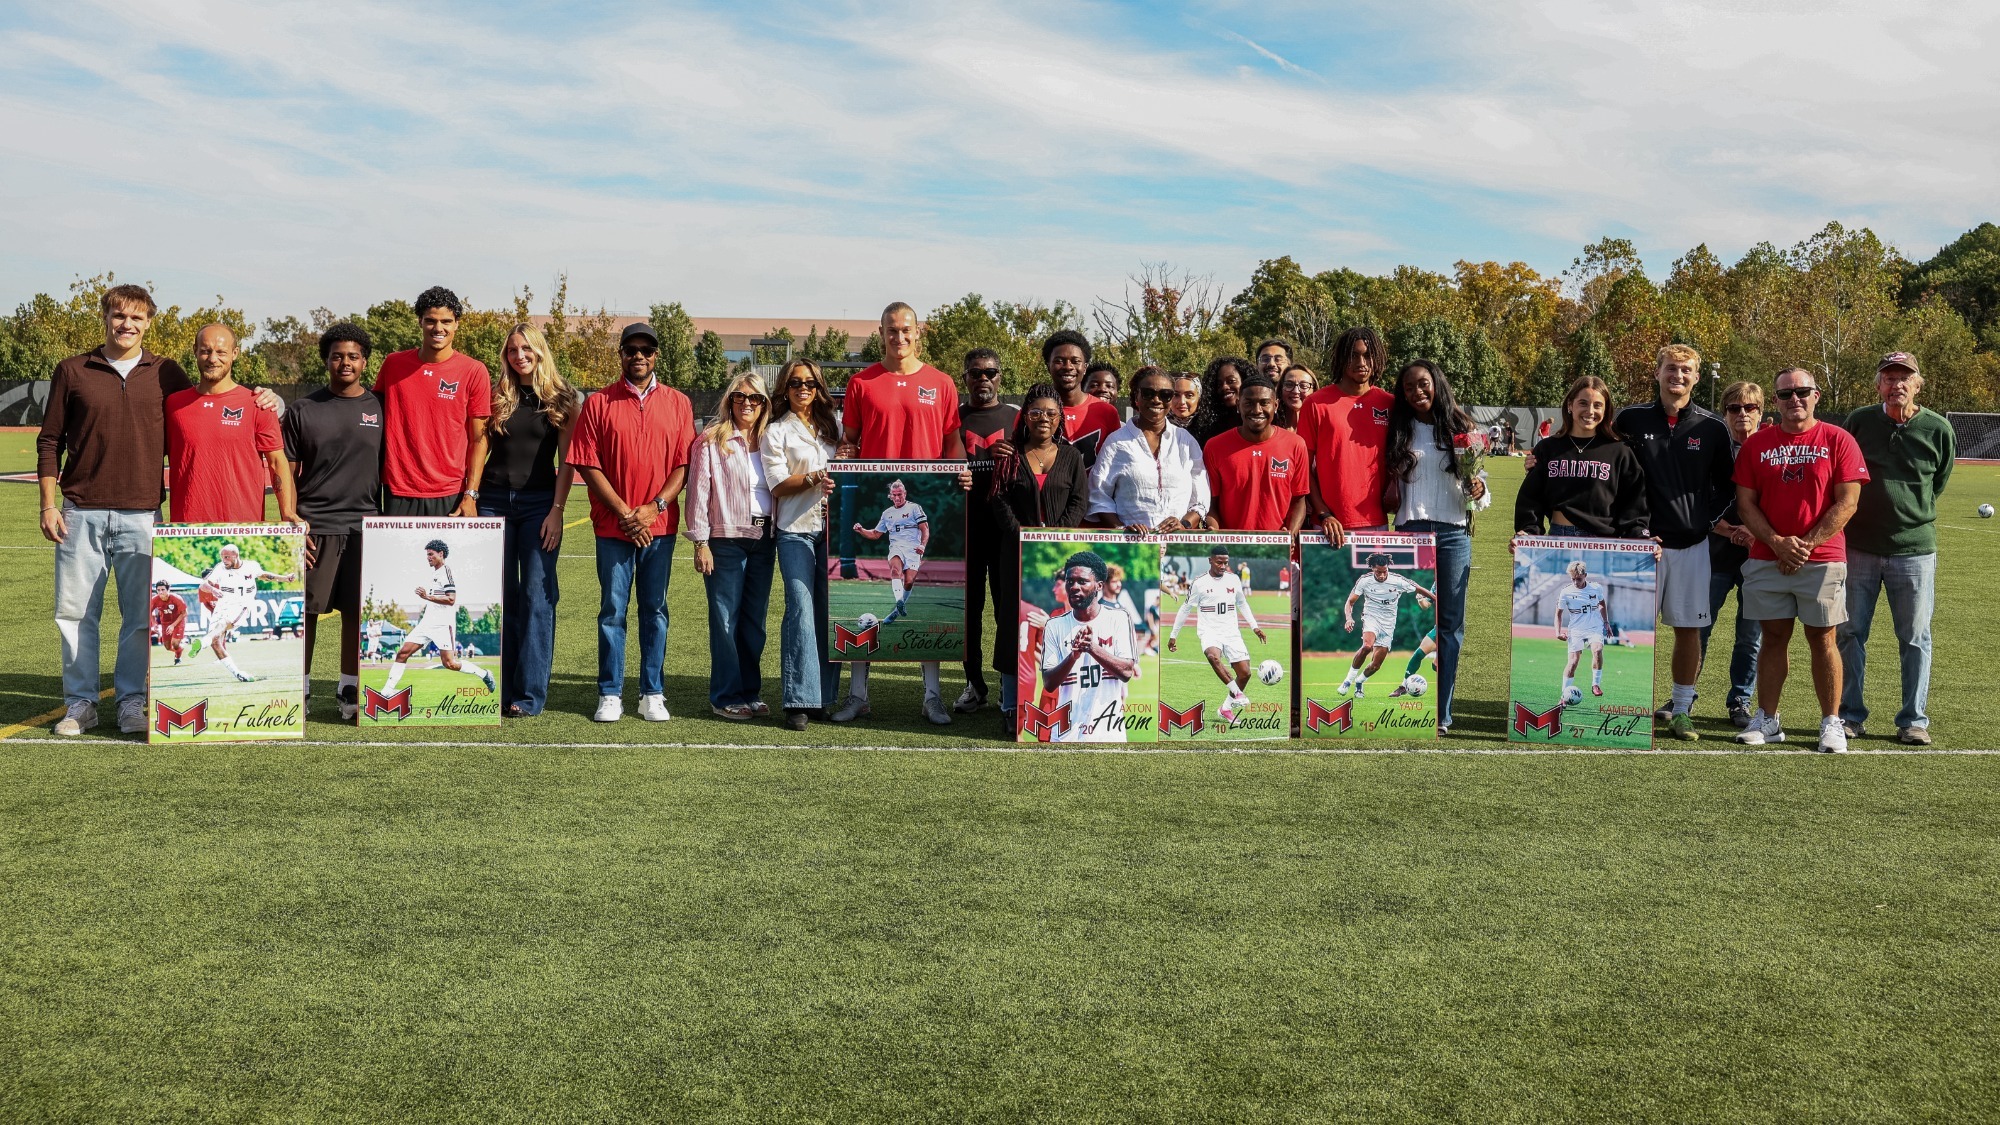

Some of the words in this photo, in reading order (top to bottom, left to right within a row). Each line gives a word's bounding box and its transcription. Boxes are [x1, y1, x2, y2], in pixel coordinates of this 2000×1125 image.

[1760, 445, 1829, 463] MARYVILLE
[1770, 455, 1817, 466] UNIVERSITY
[880, 464, 929, 472] UNIVERSITY
[931, 464, 965, 472] SOCCER
[1547, 459, 1611, 481] SAINTS
[156, 528, 208, 536] MARYVILLE
[210, 527, 265, 535] UNIVERSITY
[1023, 533, 1071, 541] MARYVILLE
[1073, 534, 1122, 542] UNIVERSITY
[1124, 534, 1158, 542] SOCCER
[1205, 535, 1254, 543] UNIVERSITY
[1350, 536, 1399, 544] UNIVERSITY
[1400, 537, 1433, 545] SOCCER
[1517, 540, 1565, 549] MARYVILLE
[1567, 541, 1618, 550] UNIVERSITY
[1620, 544, 1655, 552] SOCCER
[1217, 602, 1226, 615] 10
[897, 629, 965, 649] Stöcker
[1080, 664, 1101, 689] 20
[456, 687, 490, 697] PEDRO
[270, 699, 288, 709] JAN
[434, 694, 500, 716] Meidanis
[1120, 704, 1152, 713] AXTON
[1398, 701, 1424, 711] YAYO
[1599, 704, 1650, 716] KAMERON
[233, 704, 299, 729] Fulnek
[1092, 700, 1153, 732] Anom
[1229, 709, 1281, 730] Losada
[1374, 708, 1436, 729] Mutombo
[1597, 713, 1641, 737] Kail
